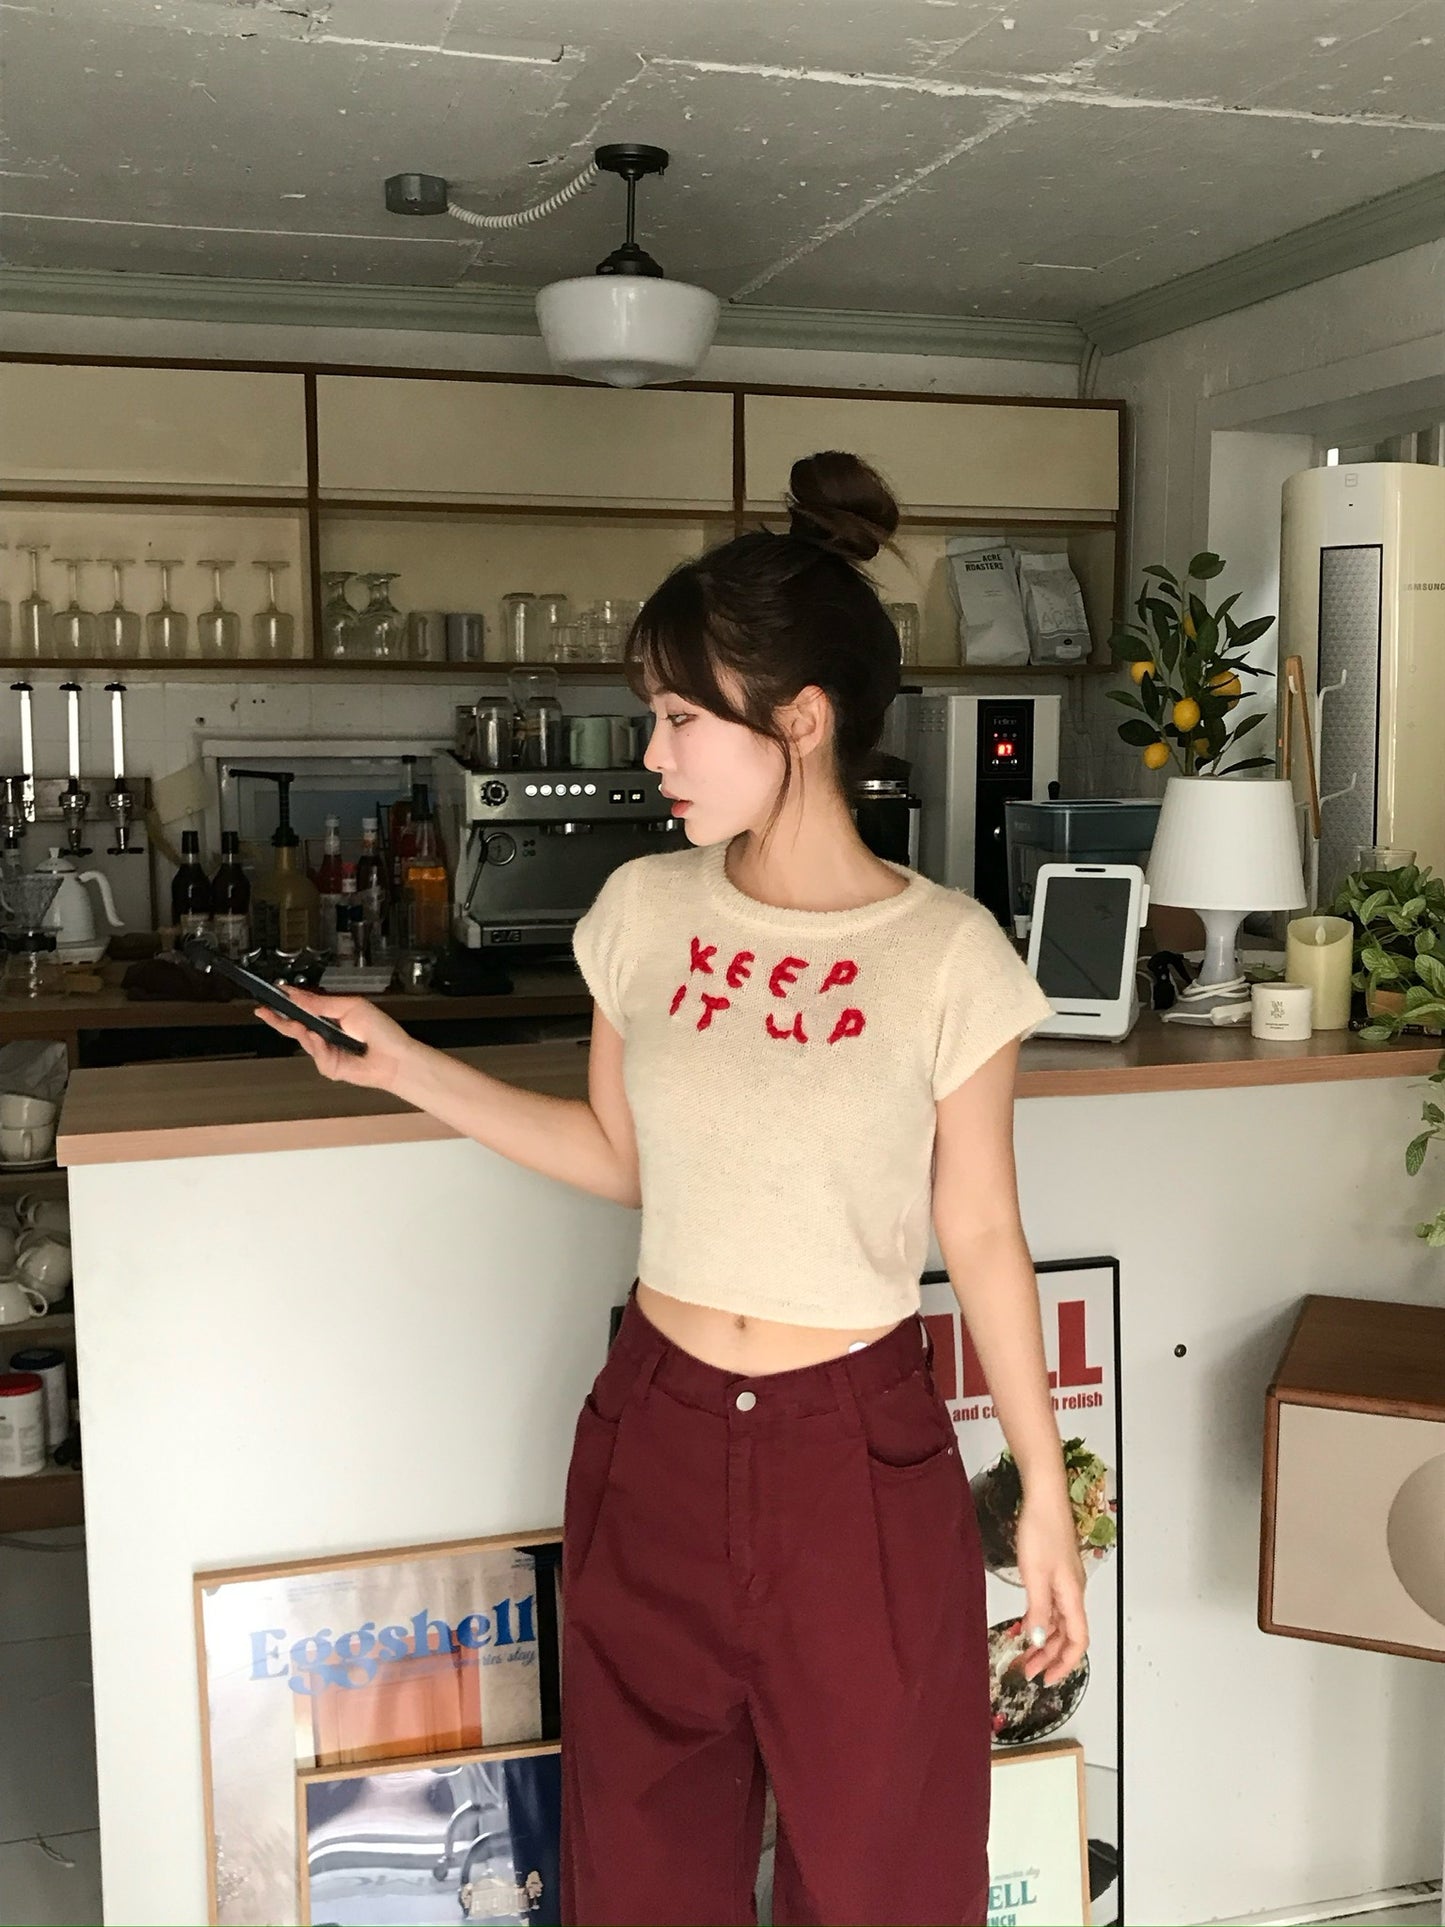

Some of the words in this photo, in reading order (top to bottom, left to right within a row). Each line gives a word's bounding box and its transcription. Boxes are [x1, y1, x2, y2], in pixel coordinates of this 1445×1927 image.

[965, 562, 1004, 572] ROASTERS
[982, 553, 1002, 562] ACRE
[1404, 582, 1445, 591] AMSUNG
[690, 936, 858, 998] KEEP
[669, 984, 731, 1032] IT
[765, 1007, 866, 1044] UP
[952, 1404, 979, 1422] and
[982, 1405, 1000, 1420] co
[1062, 1391, 1103, 1410] relish
[249, 1594, 537, 1696] Eggshell
[988, 1879, 1038, 1912] ELL
[988, 1913, 1017, 1926] NCH
